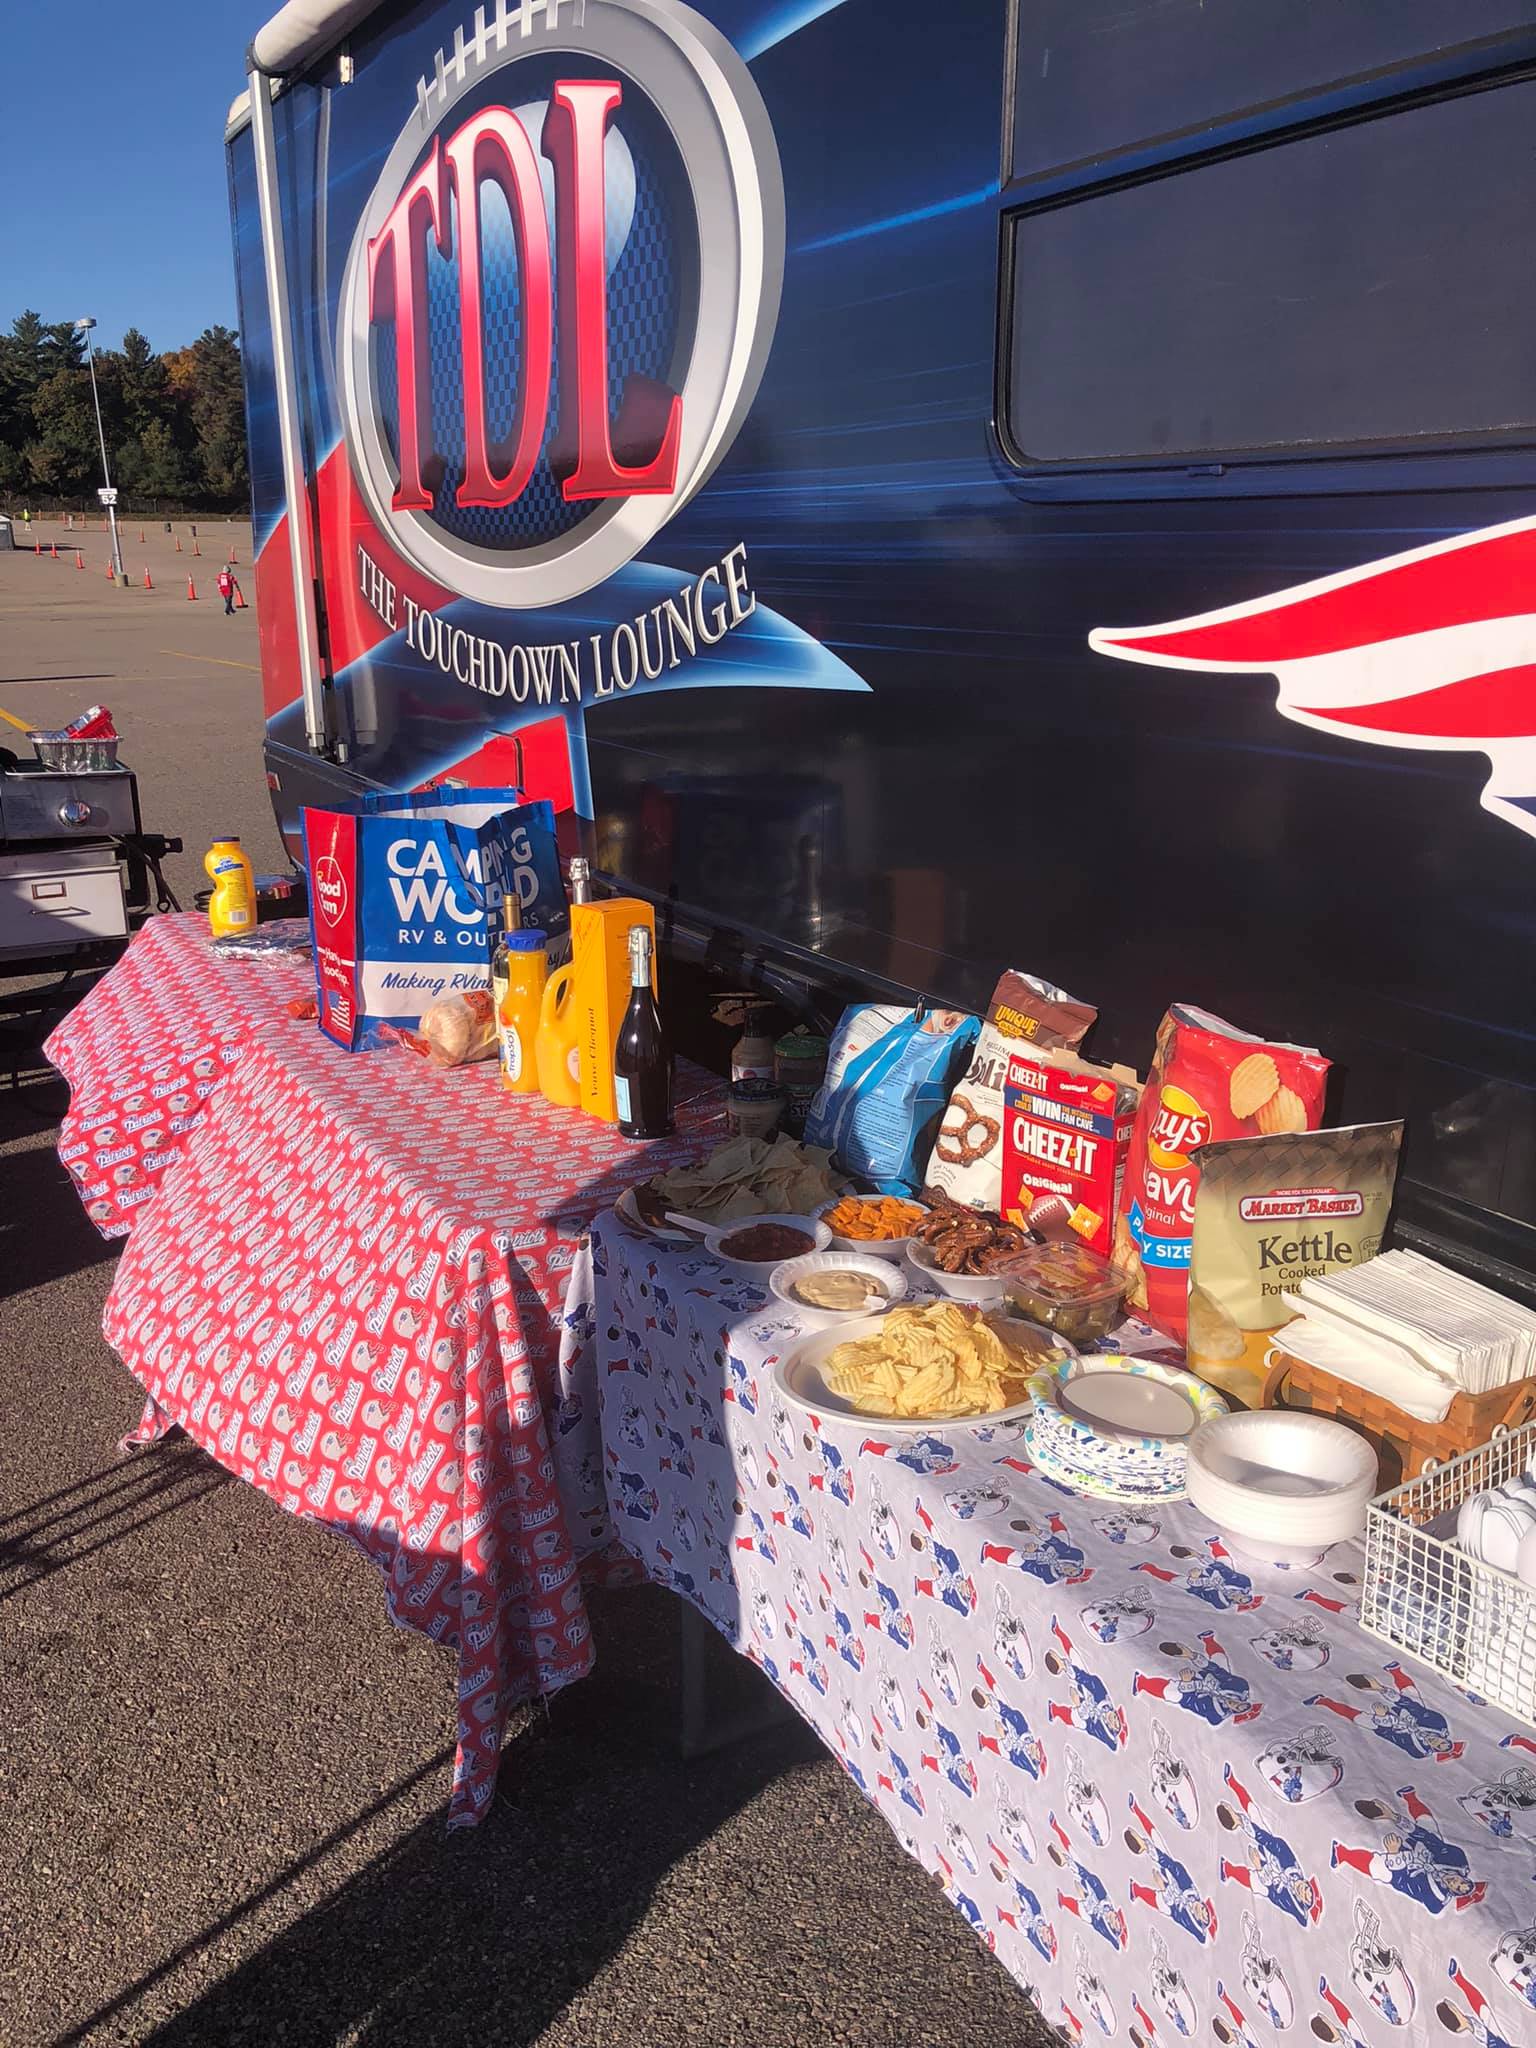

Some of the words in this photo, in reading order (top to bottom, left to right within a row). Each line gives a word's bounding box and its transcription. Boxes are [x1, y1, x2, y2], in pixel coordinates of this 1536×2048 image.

[368, 79, 683, 513] TDL
[101, 495, 117, 504] 52
[357, 543, 398, 630] THE
[402, 597, 584, 704] TOUCHDOWN
[593, 541, 756, 699] LOUNGE
[399, 929, 424, 944] RV
[433, 929, 447, 945] &
[381, 972, 446, 996] Making
[995, 1005, 1039, 1037] UNIQUE
[1031, 1096, 1061, 1121] WIN
[1144, 1160, 1196, 1223] avy
[1245, 1200, 1306, 1217] MARKET
[1306, 1198, 1357, 1213] BASKET
[1156, 1244, 1192, 1259] SIZE
[1258, 1230, 1353, 1270] Kettle
[1278, 1264, 1326, 1280] Cooked
